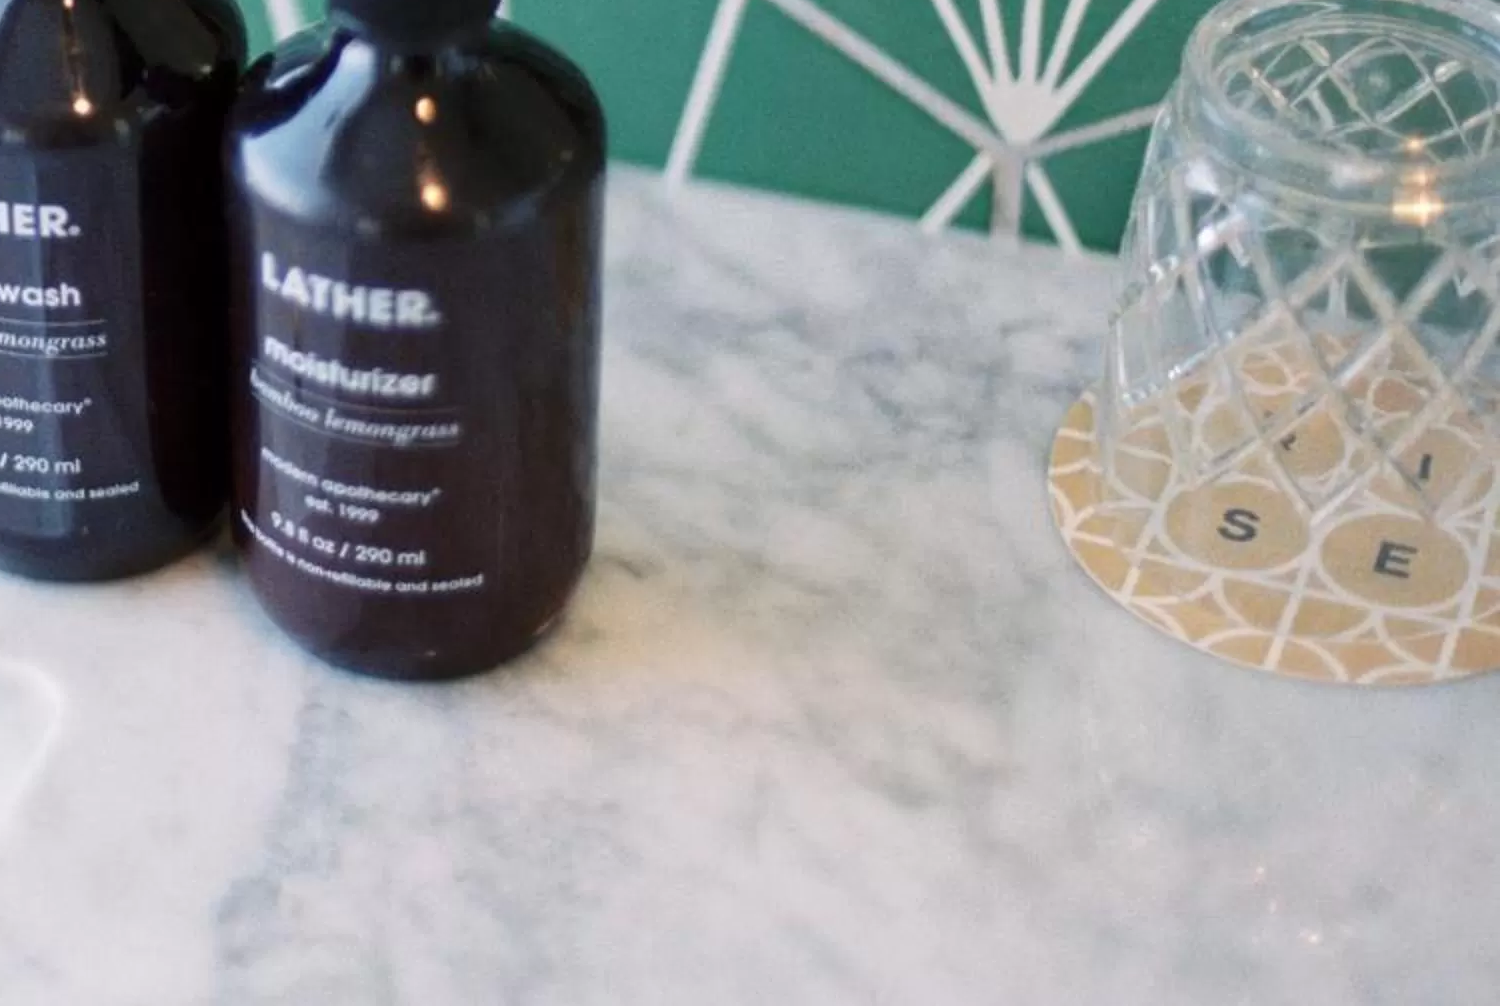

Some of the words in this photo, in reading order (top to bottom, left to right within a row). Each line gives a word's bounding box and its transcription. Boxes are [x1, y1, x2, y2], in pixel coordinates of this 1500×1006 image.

[263, 335, 437, 397] moisturizer
[323, 406, 460, 447] lemongrass
[13, 454, 50, 473] 290
[53, 457, 82, 474] ml
[54, 487, 86, 500] and
[88, 480, 140, 499] sealed
[339, 502, 380, 524] 1999
[311, 536, 336, 555] oz
[339, 541, 351, 559] /
[355, 545, 393, 565] 290
[396, 549, 427, 567] ml
[1217, 508, 1261, 543] S
[1373, 540, 1418, 580] E
[394, 579, 429, 593] and
[431, 572, 485, 593] sealed
